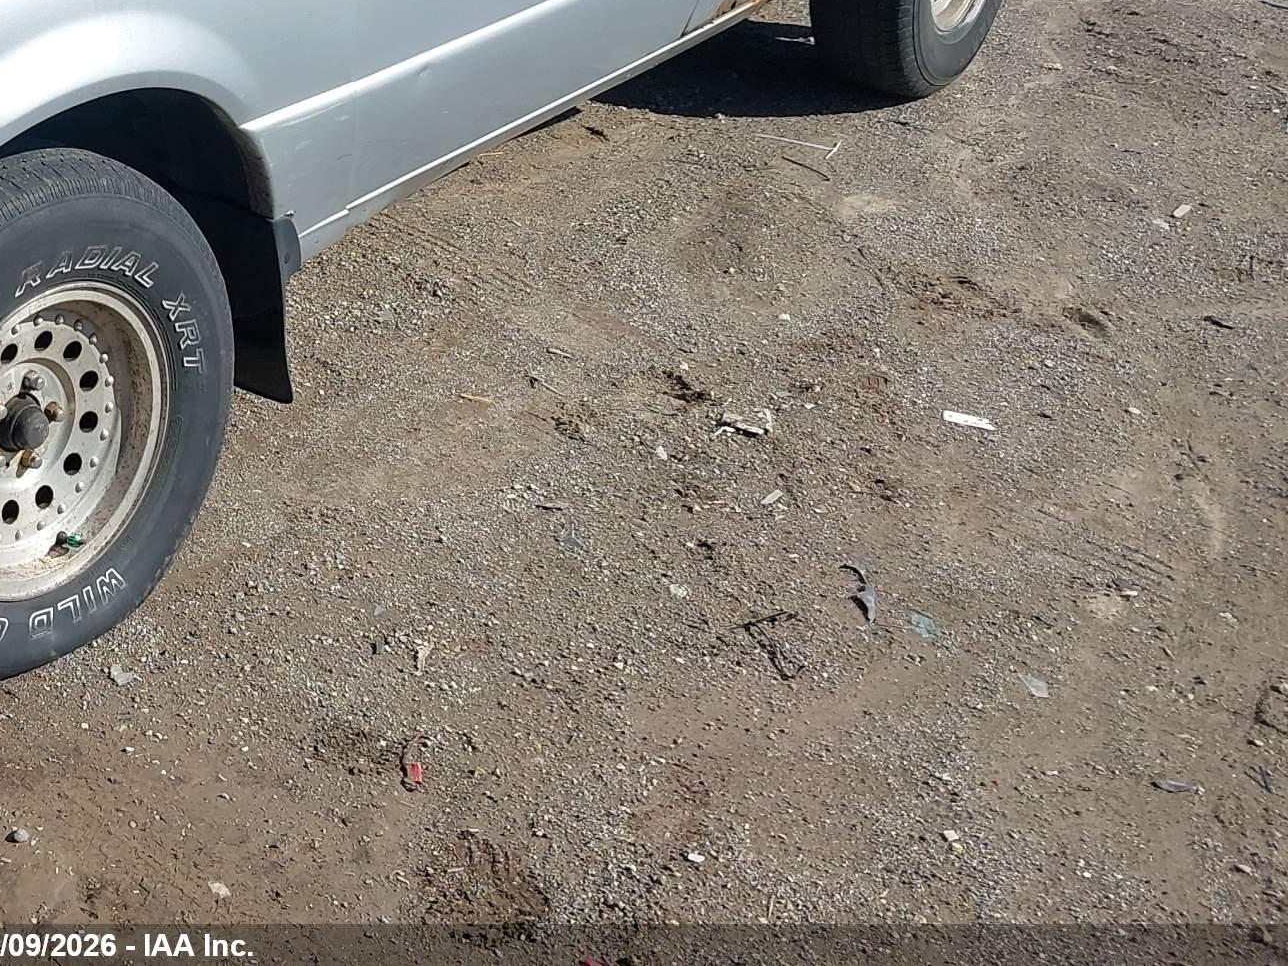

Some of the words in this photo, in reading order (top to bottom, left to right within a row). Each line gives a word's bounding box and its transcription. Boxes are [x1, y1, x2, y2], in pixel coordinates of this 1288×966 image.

[14, 244, 160, 298] RADIAL
[162, 290, 206, 374] XRT
[29, 567, 129, 639] WILD
